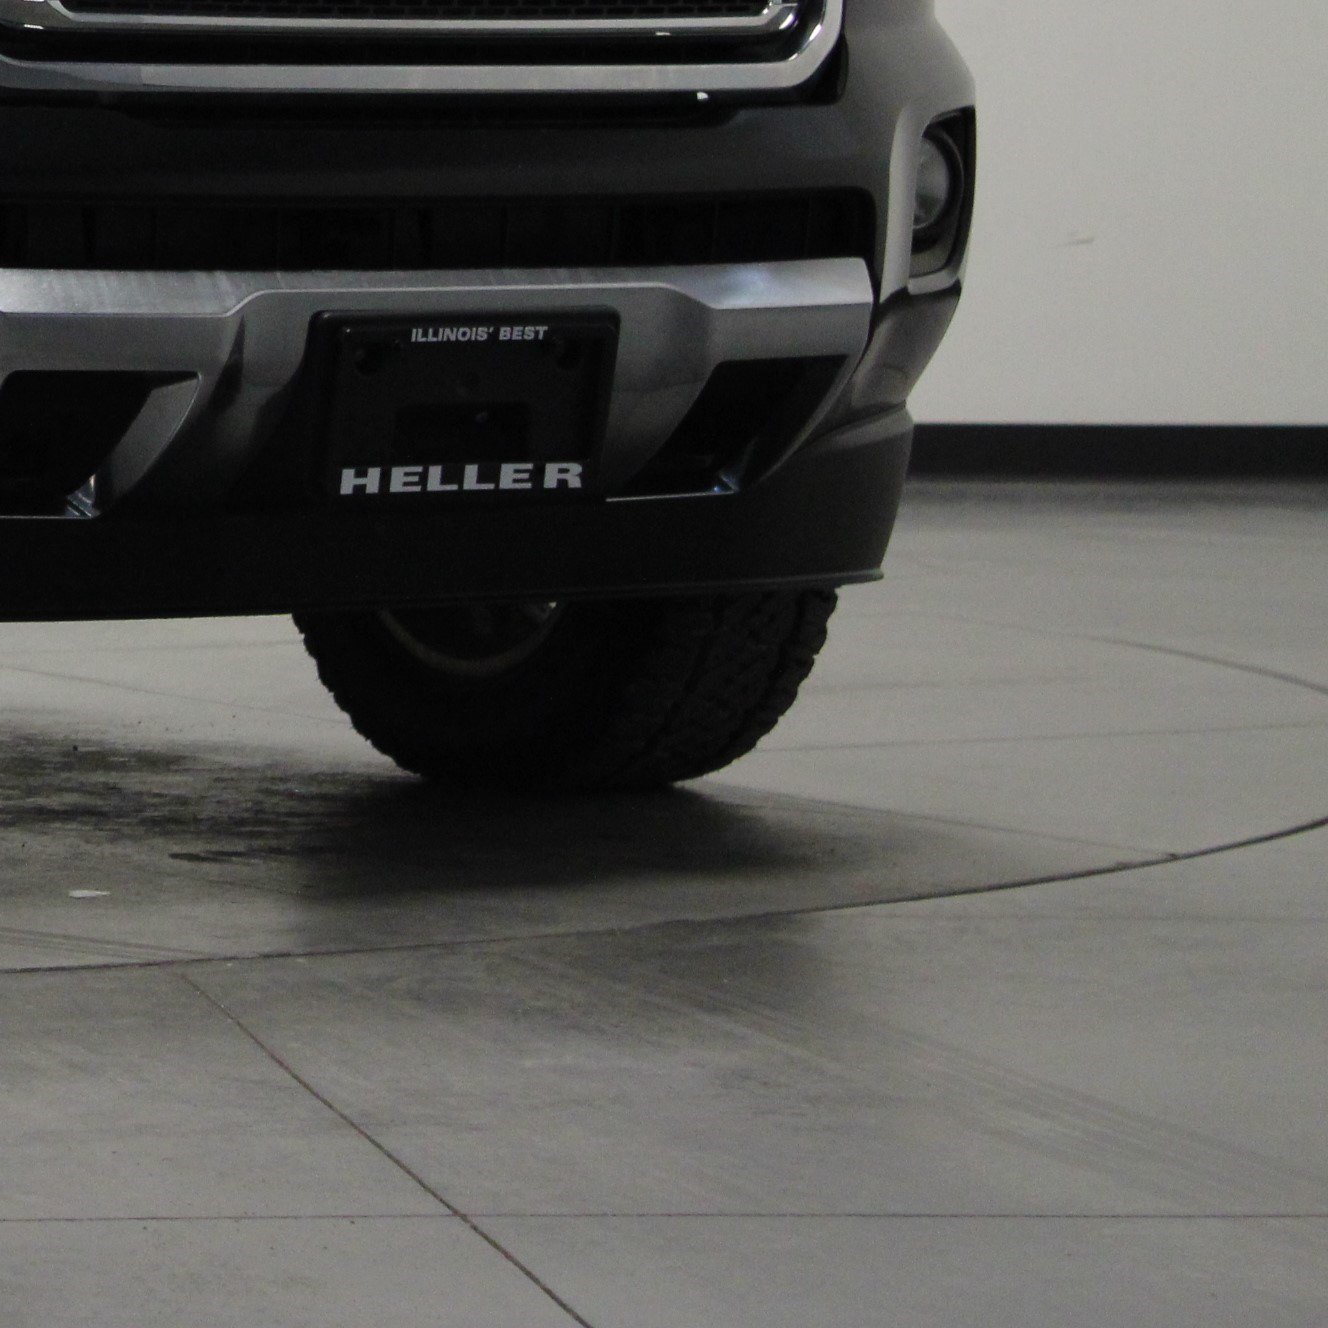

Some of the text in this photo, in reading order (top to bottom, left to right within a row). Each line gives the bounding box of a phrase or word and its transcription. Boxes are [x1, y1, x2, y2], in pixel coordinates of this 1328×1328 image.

[410, 325, 548, 343] ILLINOIS' BEST
[339, 462, 584, 495] HELLER
